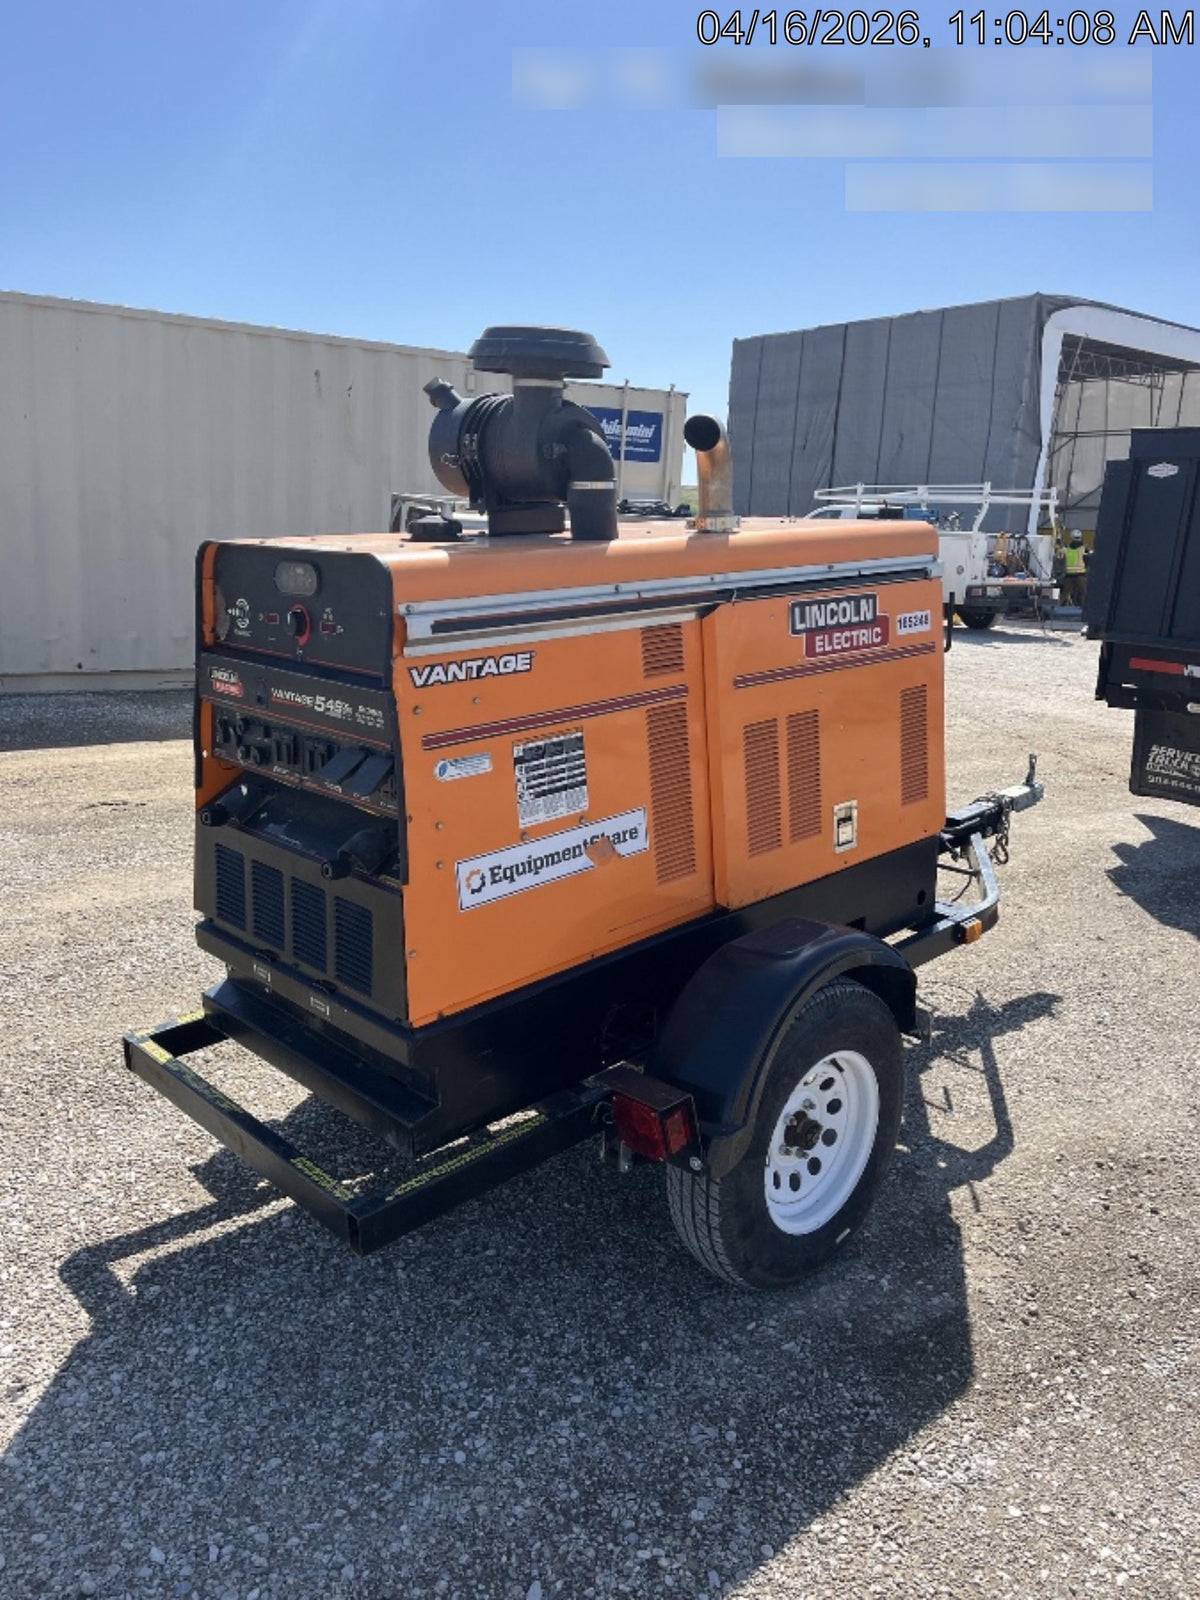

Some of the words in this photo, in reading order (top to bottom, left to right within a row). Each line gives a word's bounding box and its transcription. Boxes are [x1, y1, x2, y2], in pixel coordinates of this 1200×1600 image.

[794, 599, 874, 630] LINCOLN
[815, 627, 882, 653] ELECTRIC
[409, 651, 532, 688] VANTAGE
